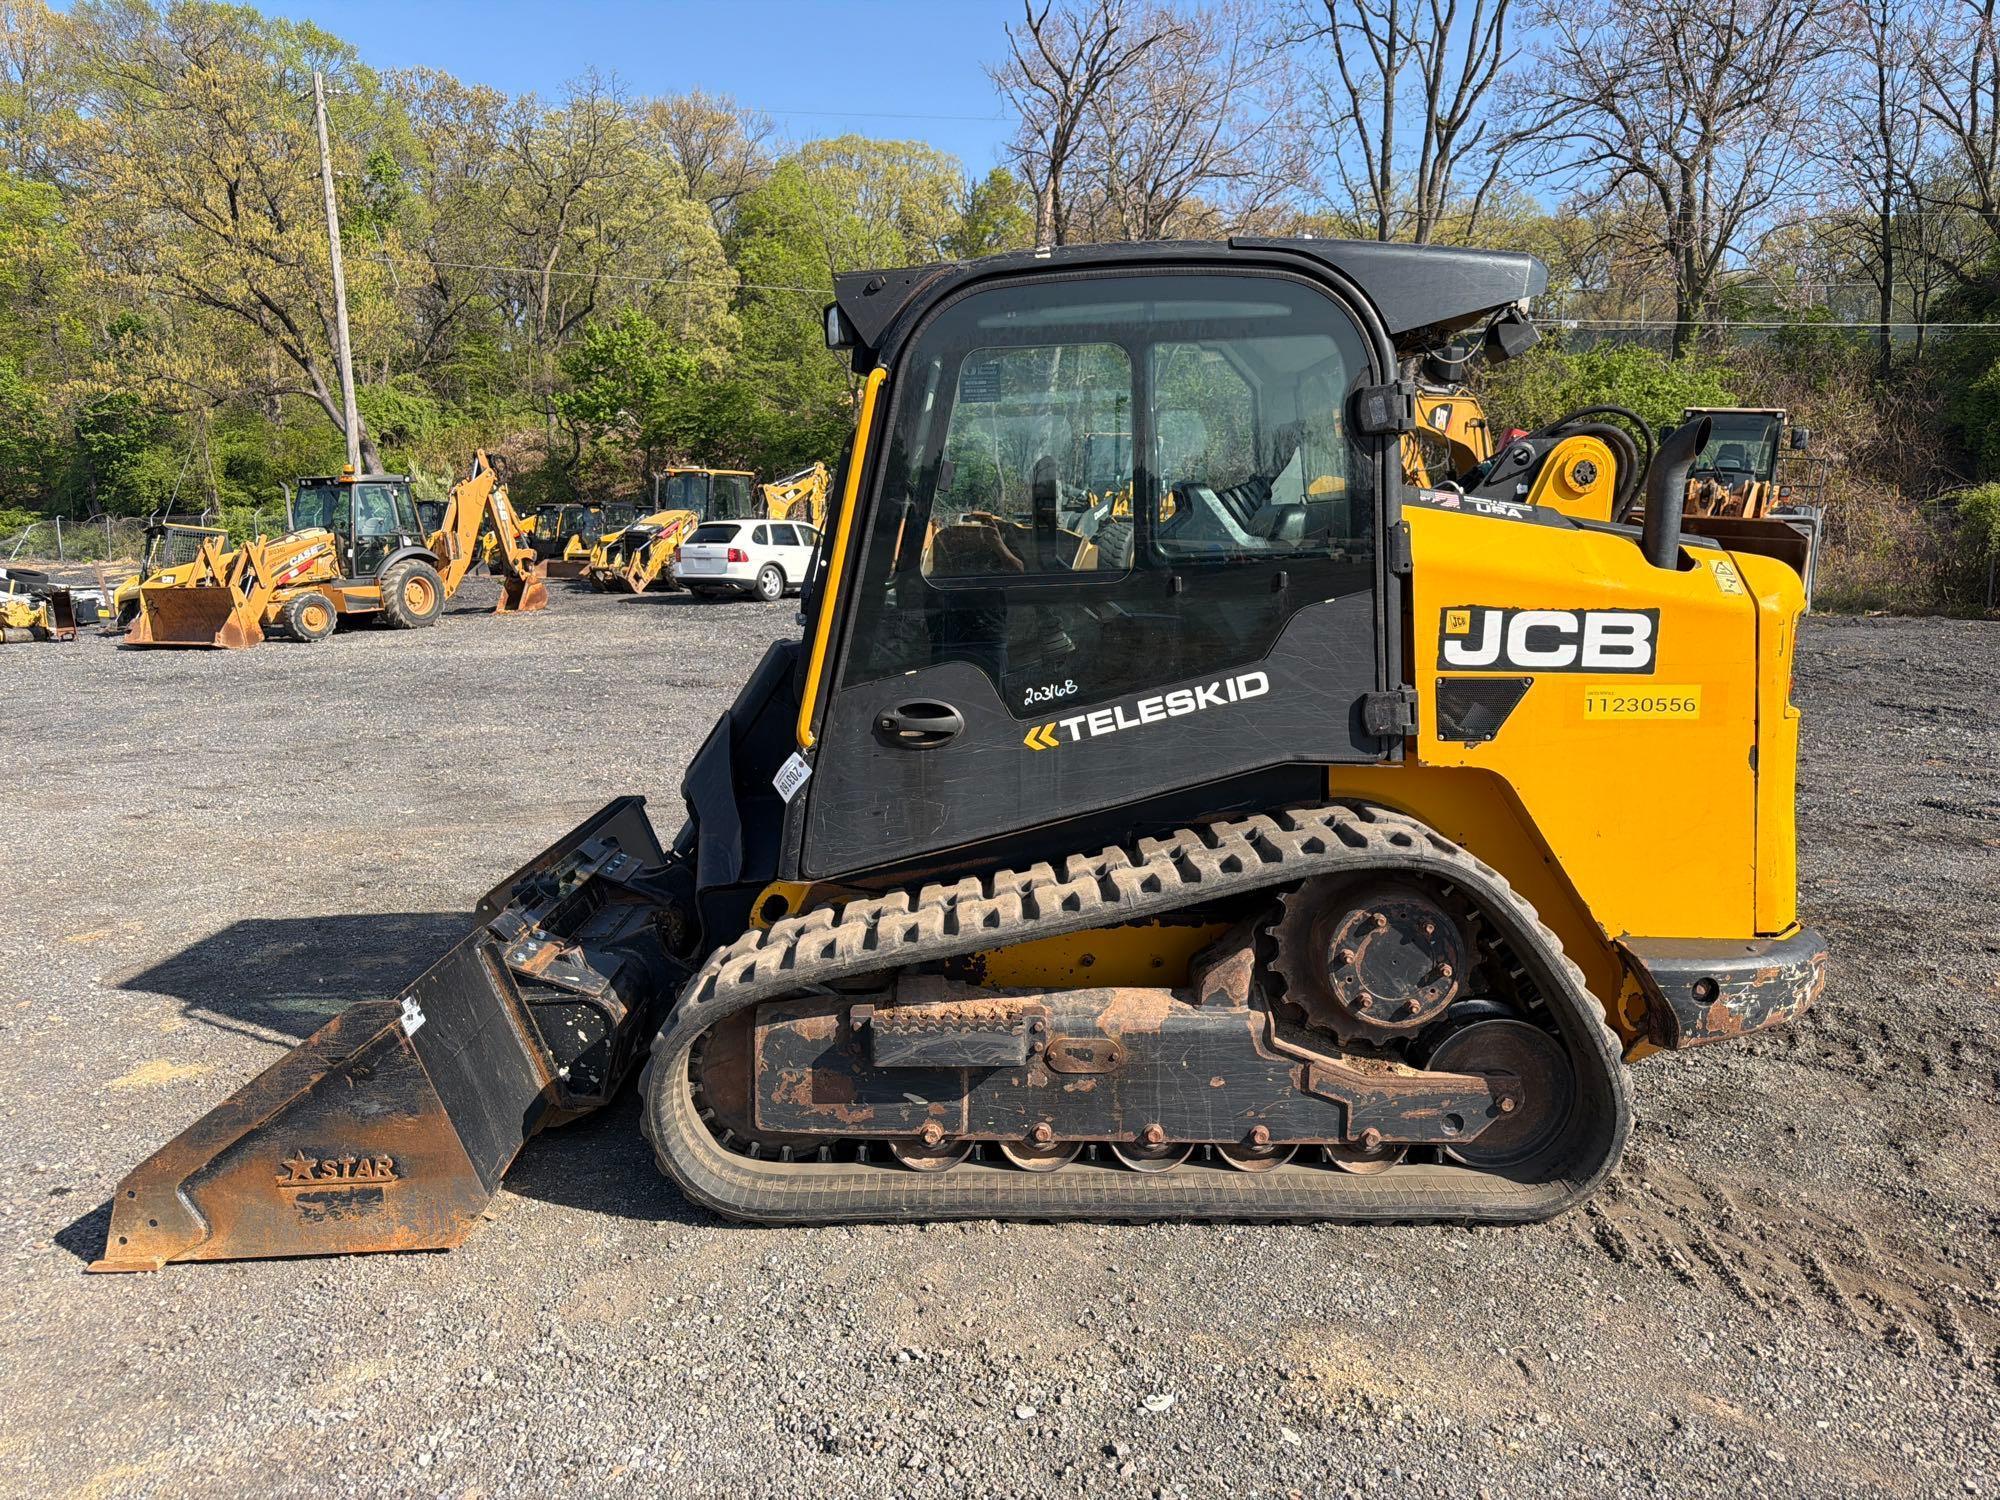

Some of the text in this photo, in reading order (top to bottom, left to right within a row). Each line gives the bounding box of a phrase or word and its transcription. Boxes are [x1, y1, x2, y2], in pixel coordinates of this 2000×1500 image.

[1476, 503, 1523, 519] USA
[289, 545, 319, 566] CASE
[1444, 610, 1652, 668] JCB
[1024, 679, 1078, 706] 203168
[1586, 698, 1697, 712] 11230556
[1060, 671, 1270, 741] TELESKID
[780, 766, 802, 795] 203168
[320, 1156, 398, 1180] STAR
